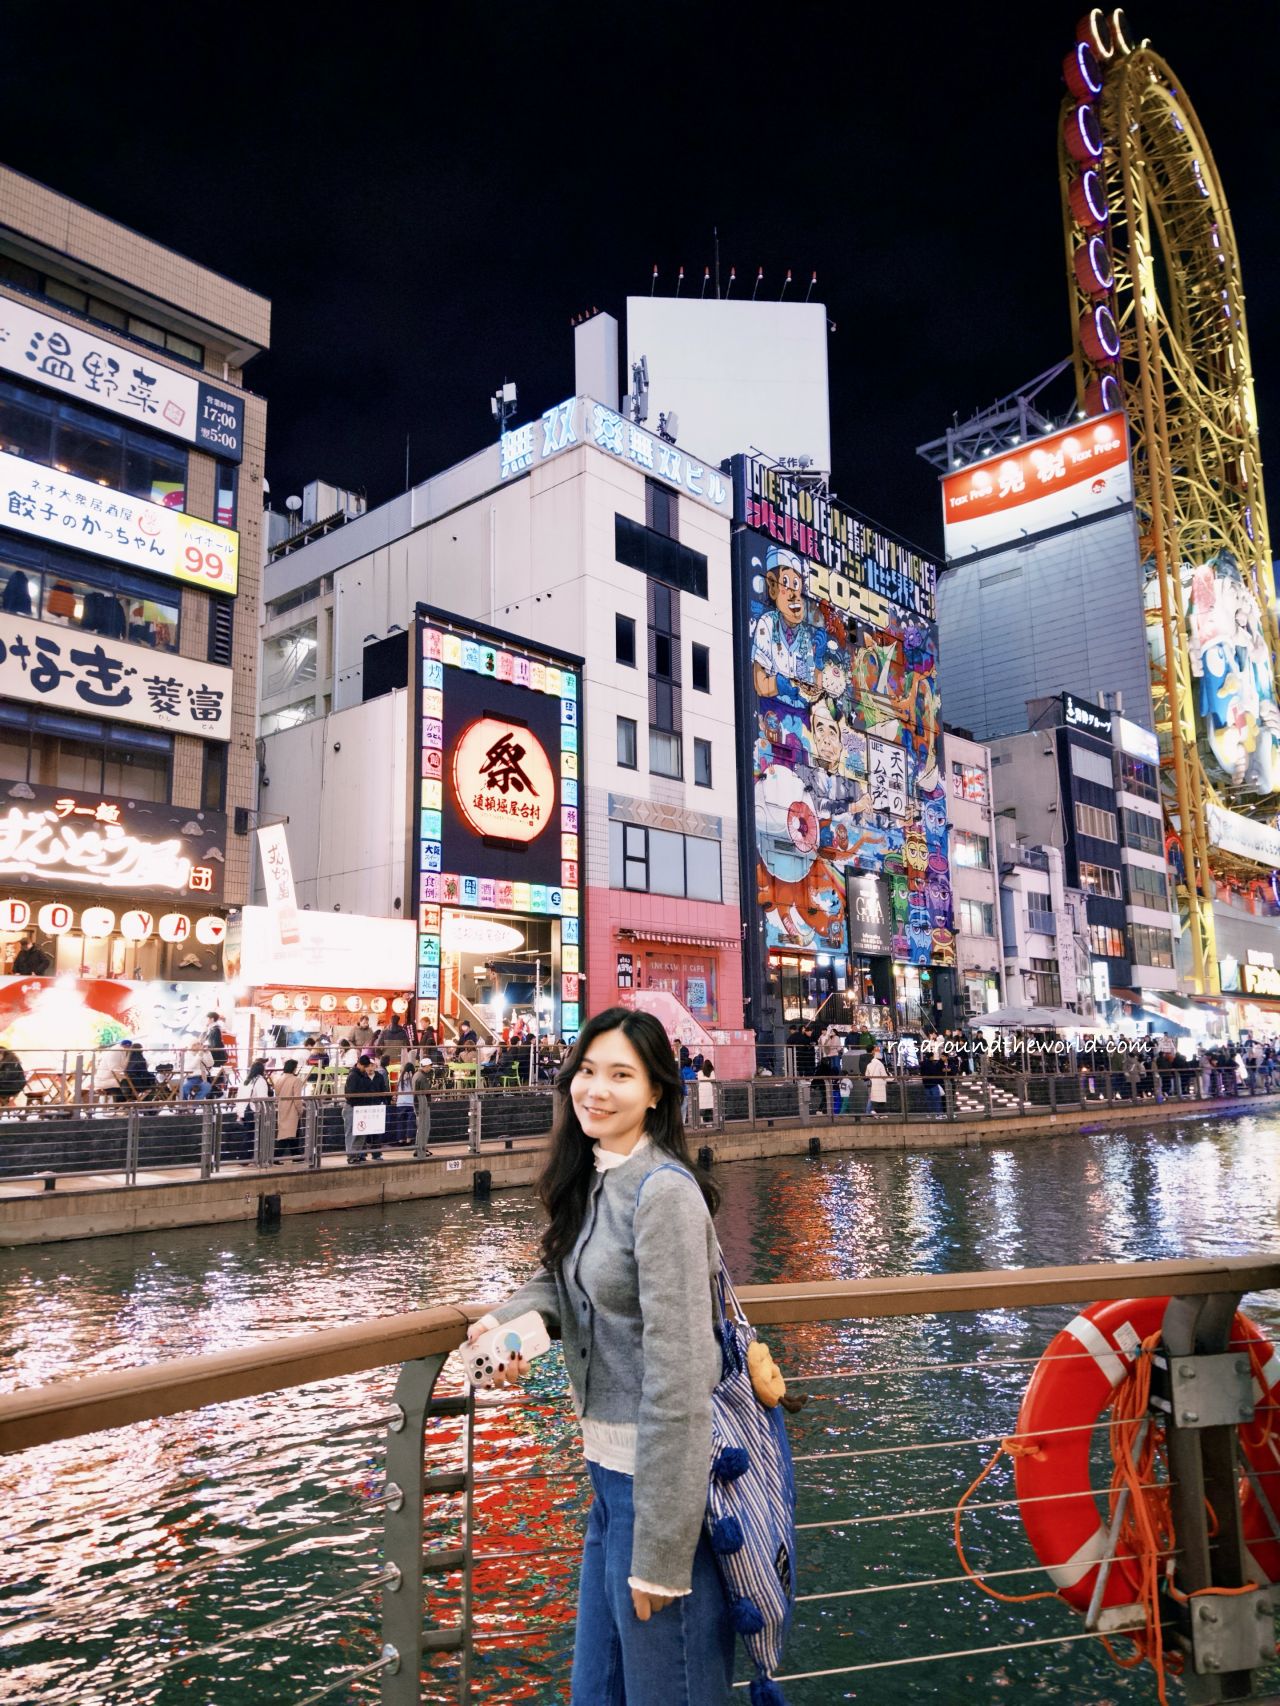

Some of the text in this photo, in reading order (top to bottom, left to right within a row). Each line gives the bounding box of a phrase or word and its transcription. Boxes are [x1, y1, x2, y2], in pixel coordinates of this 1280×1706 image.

[25, 332, 160, 414] 温野菜
[203, 405, 236, 430] 17:00
[501, 397, 577, 479] 無双
[8, 490, 165, 556] 餃子のかっちゃん
[31, 480, 133, 521] ネオ大衆居酒屋
[949, 494, 969, 508] Tax
[809, 559, 890, 631] 2025
[0, 633, 137, 707] なぎ
[143, 676, 224, 722] 菱富
[479, 731, 540, 797] 祭
